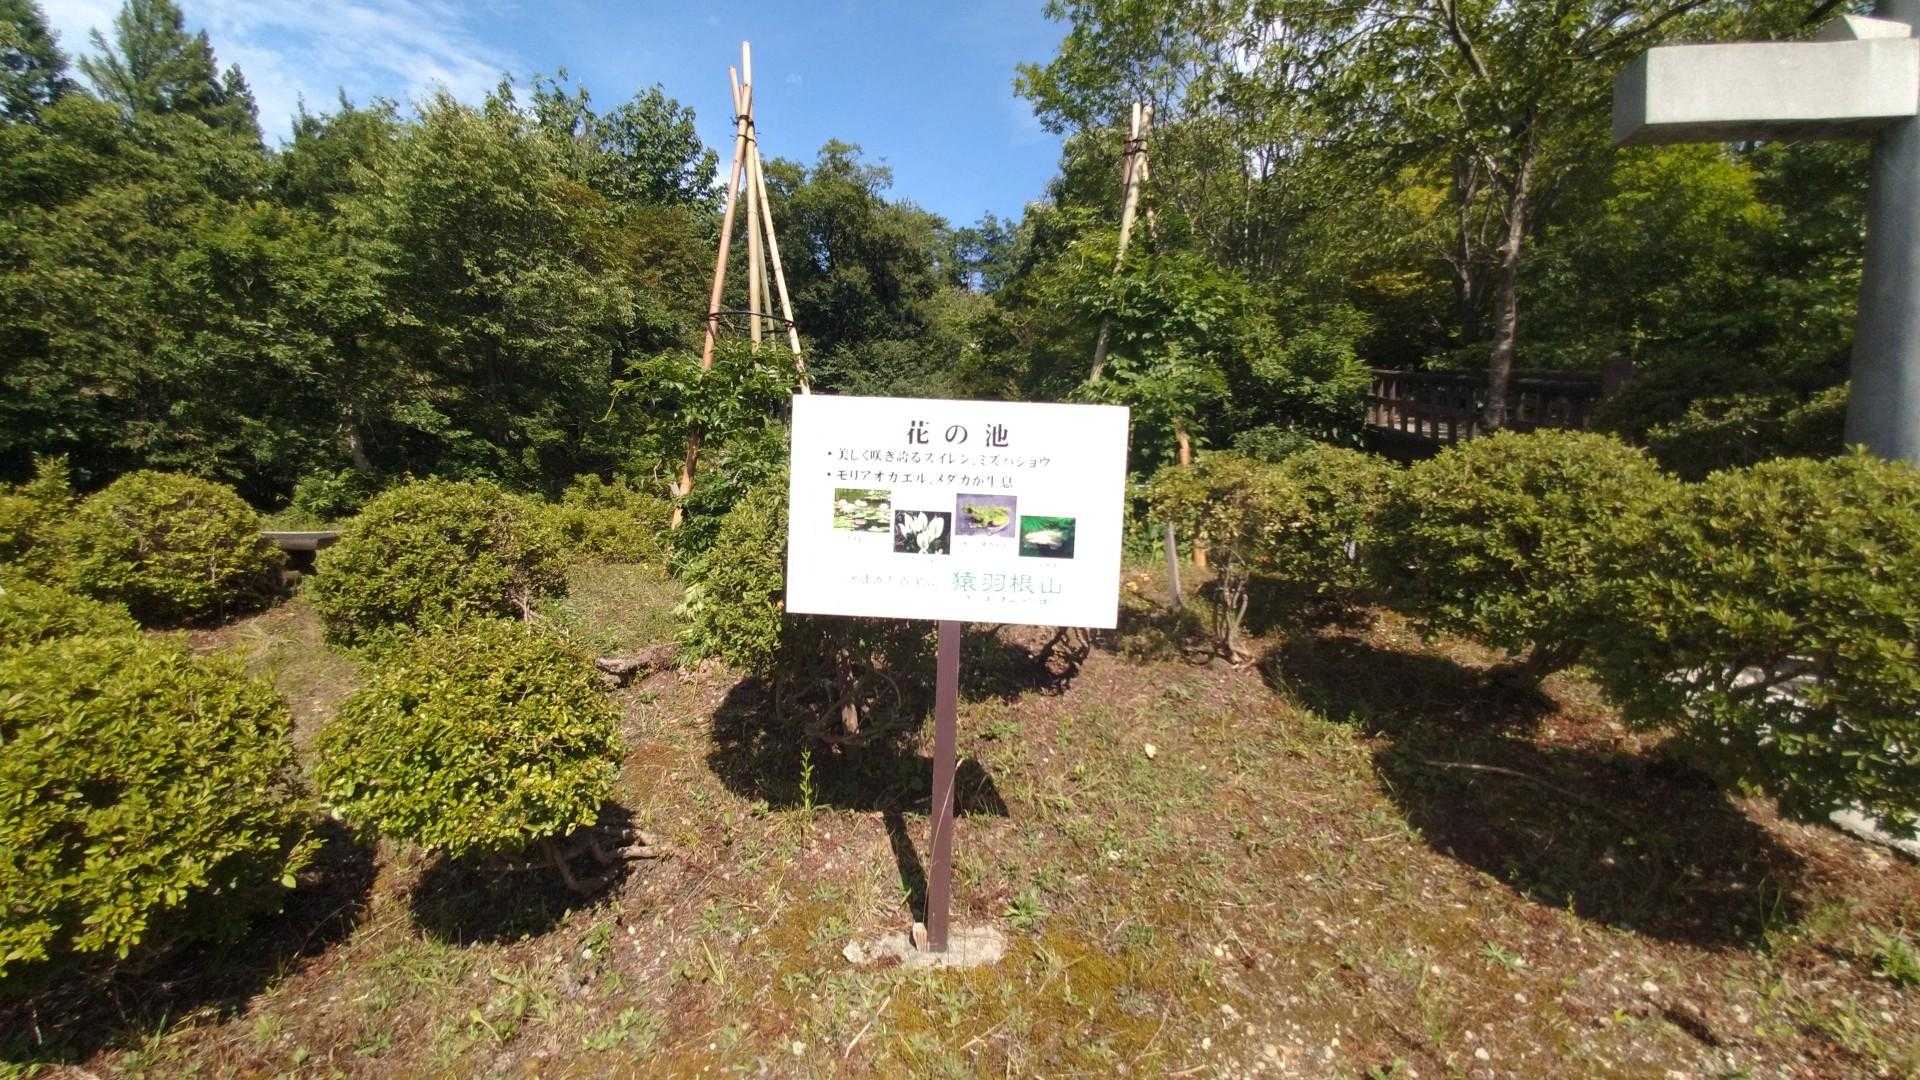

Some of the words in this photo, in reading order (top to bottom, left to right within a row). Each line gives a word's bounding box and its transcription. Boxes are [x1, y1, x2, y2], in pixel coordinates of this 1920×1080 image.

[907, 420, 1009, 447] 花の池
[952, 570, 1062, 594] 猿羽根山
